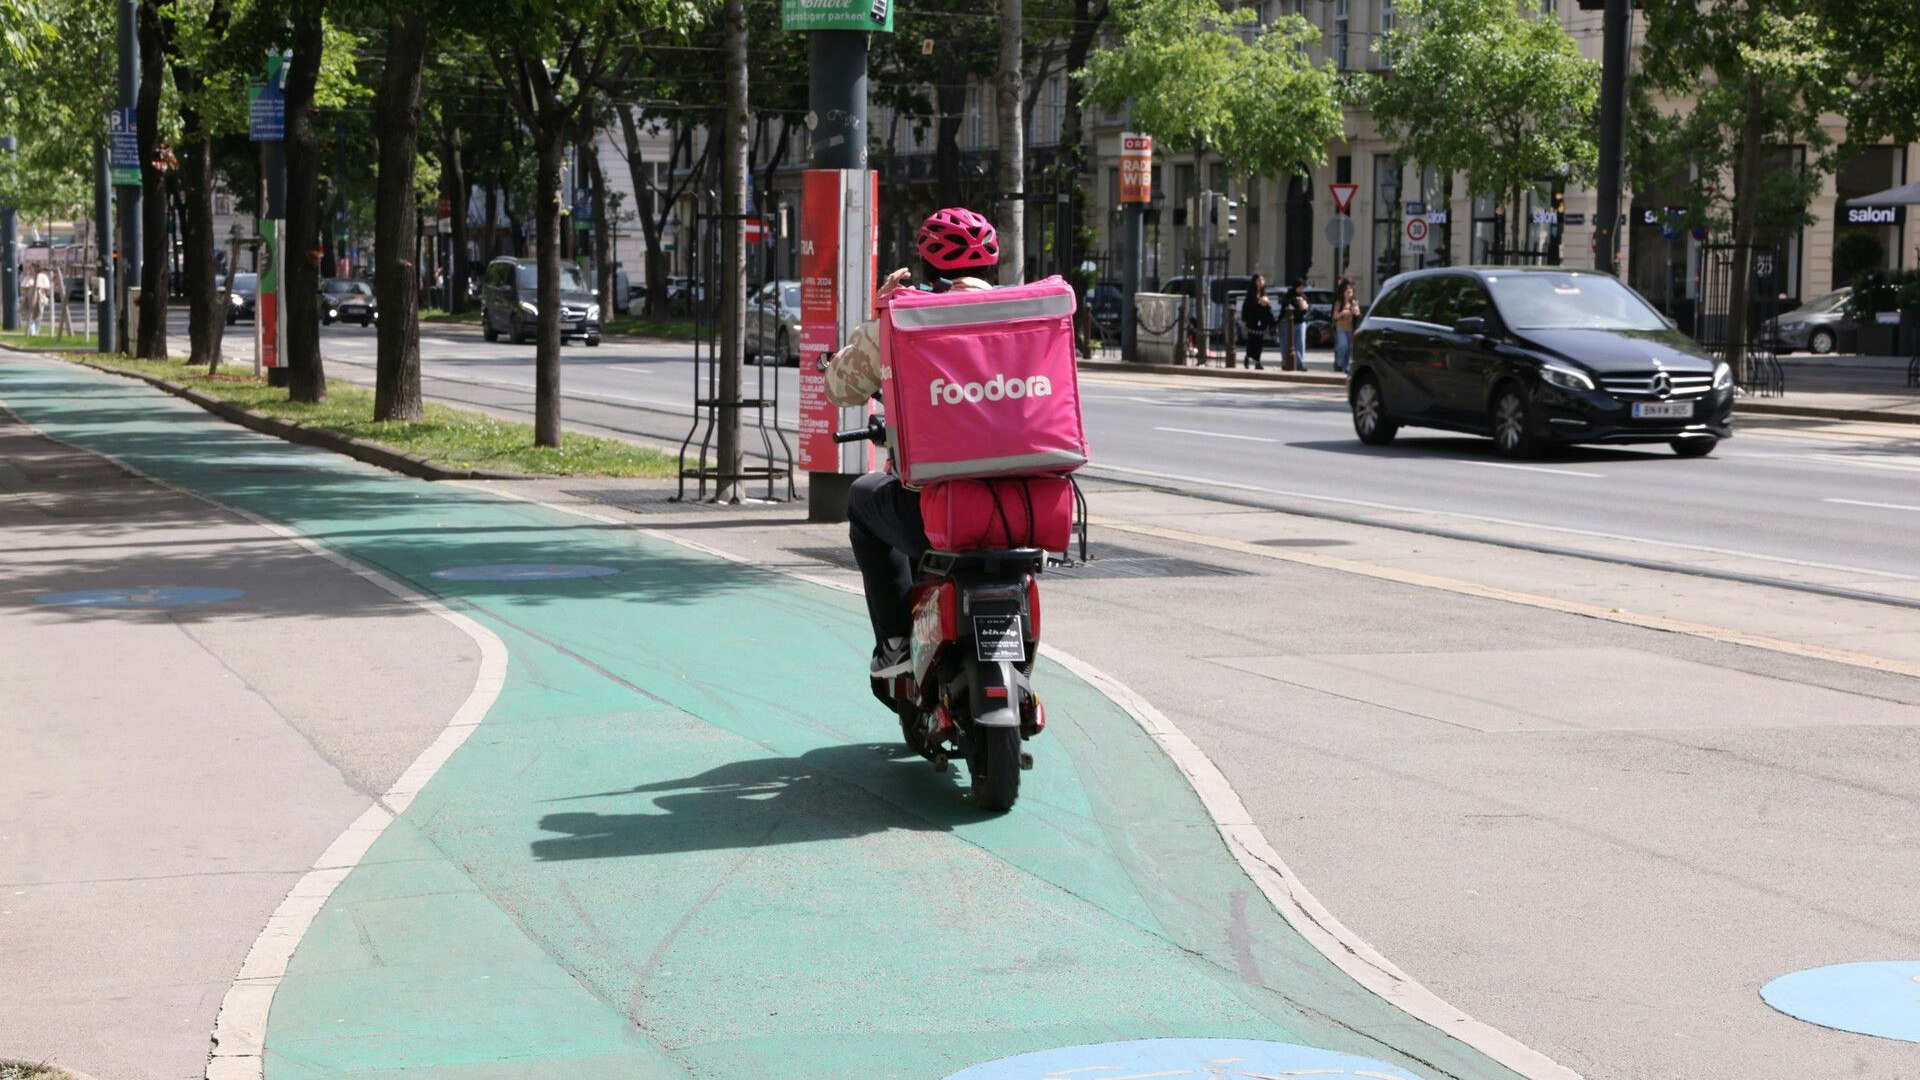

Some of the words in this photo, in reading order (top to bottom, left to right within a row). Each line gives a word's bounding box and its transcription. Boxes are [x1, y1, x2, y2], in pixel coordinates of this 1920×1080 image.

[786, 11, 826, 23] günstiger
[828, 12, 866, 23] parken!
[1126, 140, 1149, 148] ORF
[1848, 206, 1895, 223] saloni
[1412, 224, 1422, 235] 30
[930, 373, 1052, 406] foodora
